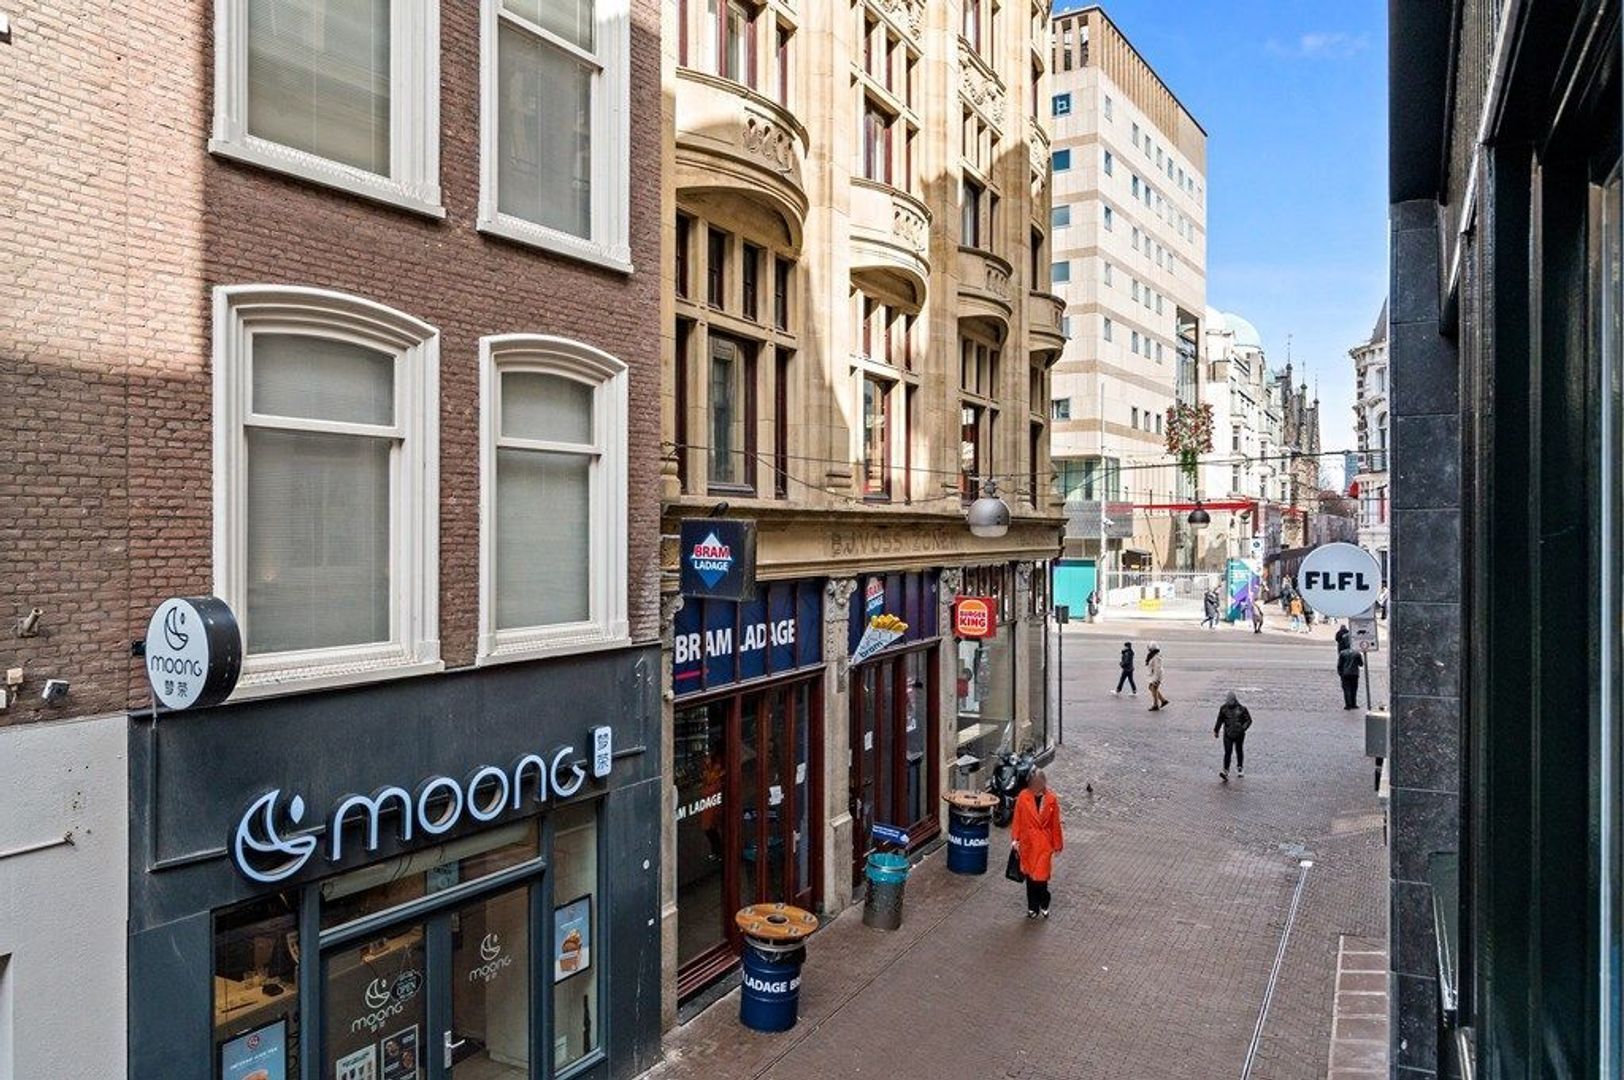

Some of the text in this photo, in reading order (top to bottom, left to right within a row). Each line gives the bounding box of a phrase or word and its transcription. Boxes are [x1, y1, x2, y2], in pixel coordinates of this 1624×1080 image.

[693, 545, 731, 558] BRAM
[694, 560, 729, 571] LADAGE
[1305, 571, 1370, 591] FLFL
[960, 617, 986, 628] KING
[675, 627, 733, 664] BRAM
[688, 792, 723, 816] LADAGE
[745, 973, 788, 993] LADAGE
